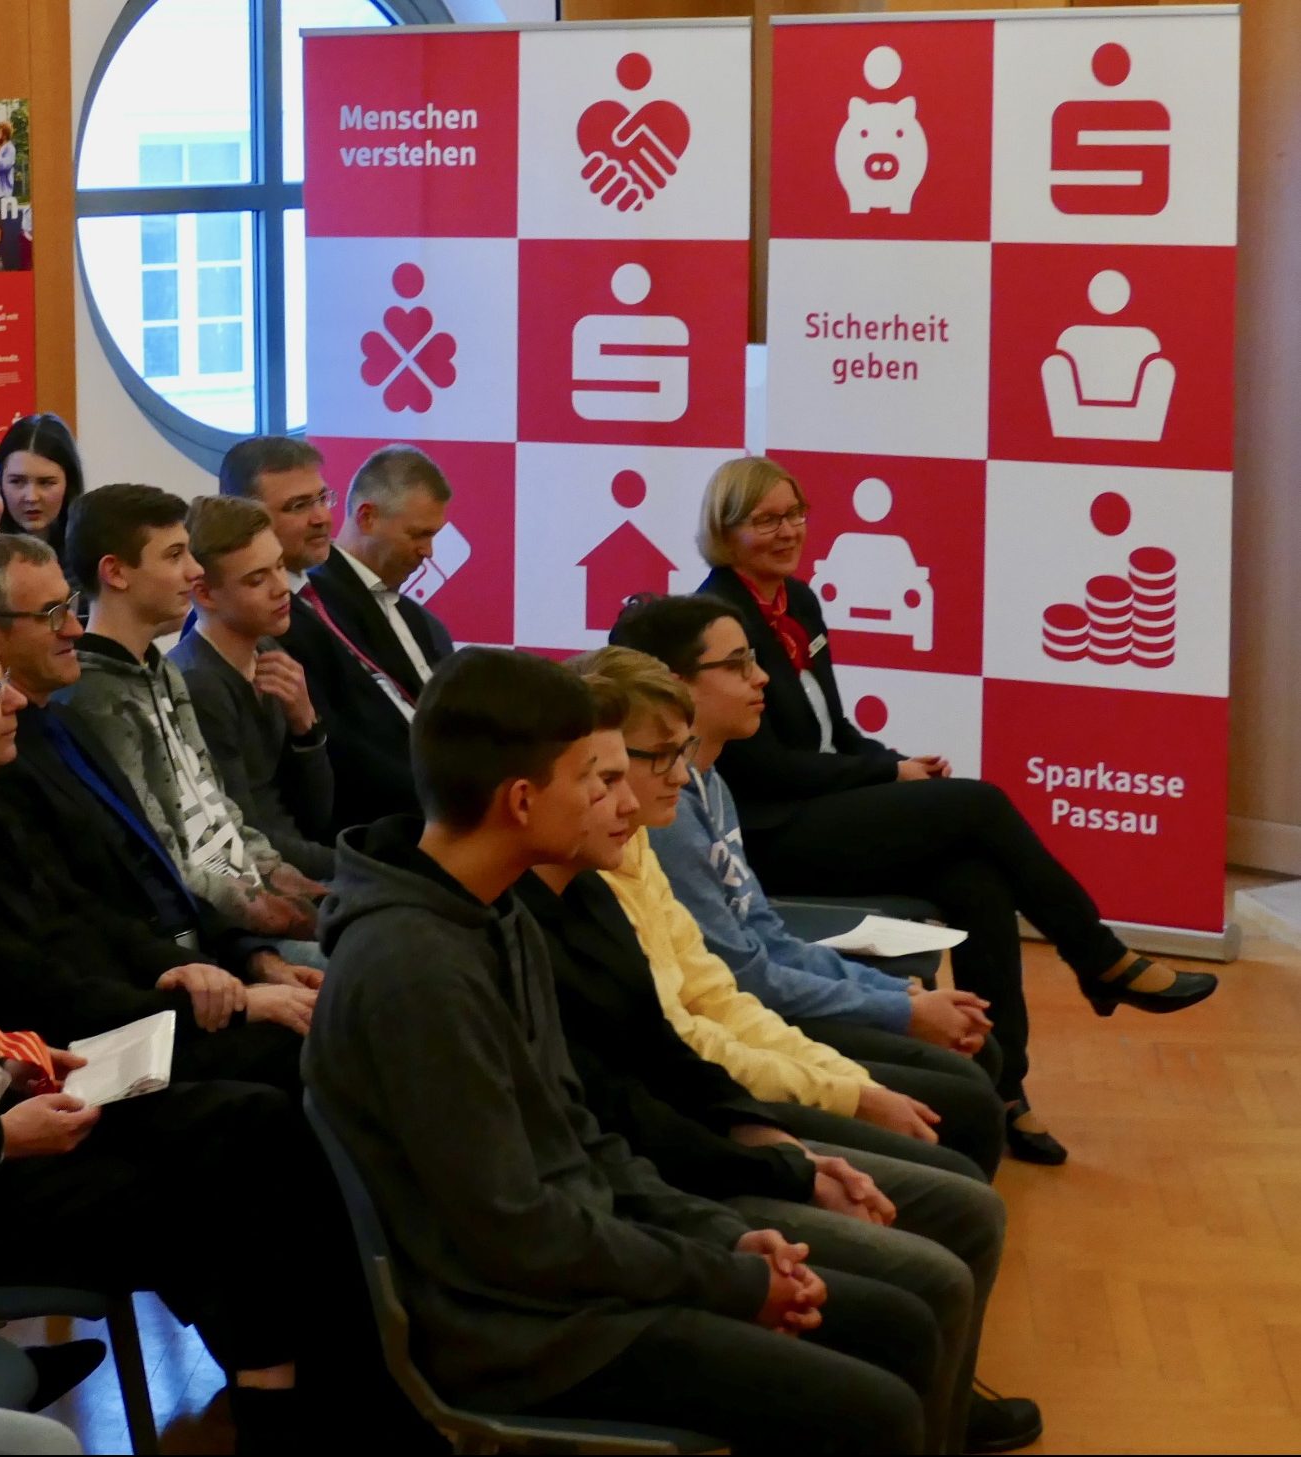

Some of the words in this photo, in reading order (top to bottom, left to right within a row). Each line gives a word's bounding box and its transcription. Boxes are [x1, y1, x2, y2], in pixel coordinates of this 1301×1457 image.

[339, 103, 478, 131] Menschen
[339, 139, 476, 167] verstehen
[805, 312, 949, 342] Sicherheit
[832, 352, 918, 384] geben
[1026, 756, 1185, 798] Sparkasse
[1051, 798, 1158, 835] Passau
